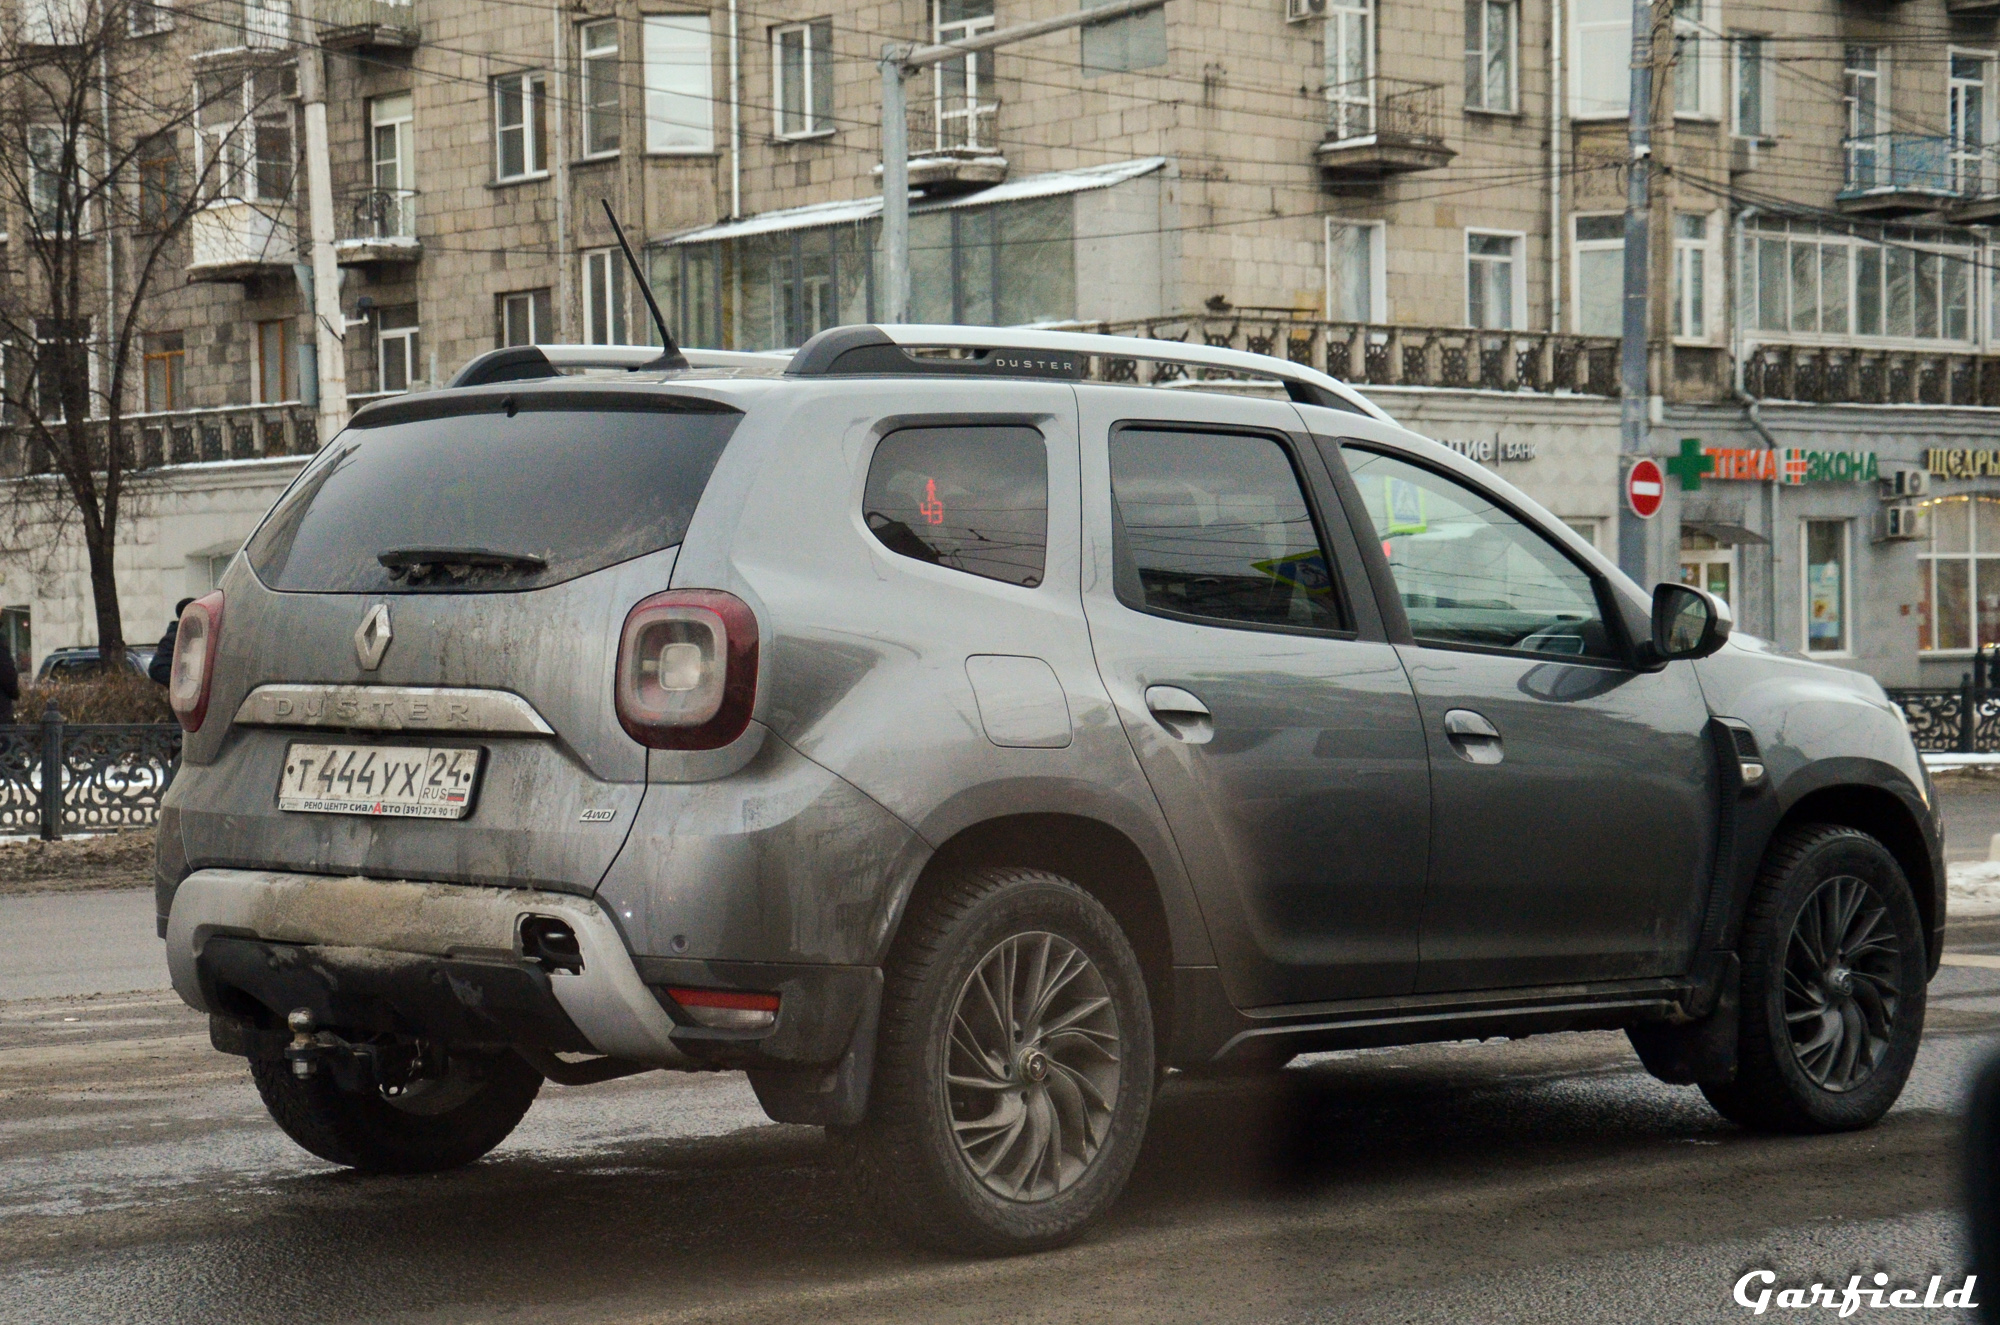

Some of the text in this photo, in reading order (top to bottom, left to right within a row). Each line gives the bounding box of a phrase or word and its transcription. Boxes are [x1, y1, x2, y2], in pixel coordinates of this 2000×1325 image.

[996, 358, 1073, 371] DUSTER
[1504, 442, 1538, 461] БАНК
[1700, 447, 1880, 482] ПТЕКА ЭКОНА
[275, 697, 469, 723] DUSTER
[428, 752, 463, 788] 24
[422, 787, 447, 800] RUS
[303, 801, 324, 811] РЕНО
[324, 802, 348, 812] ЦЕНТР
[402, 805, 421, 816] (391)
[423, 806, 438, 816] 274
[439, 807, 448, 816] 90
[450, 808, 458, 817] 11
[582, 809, 611, 820] 4WD
